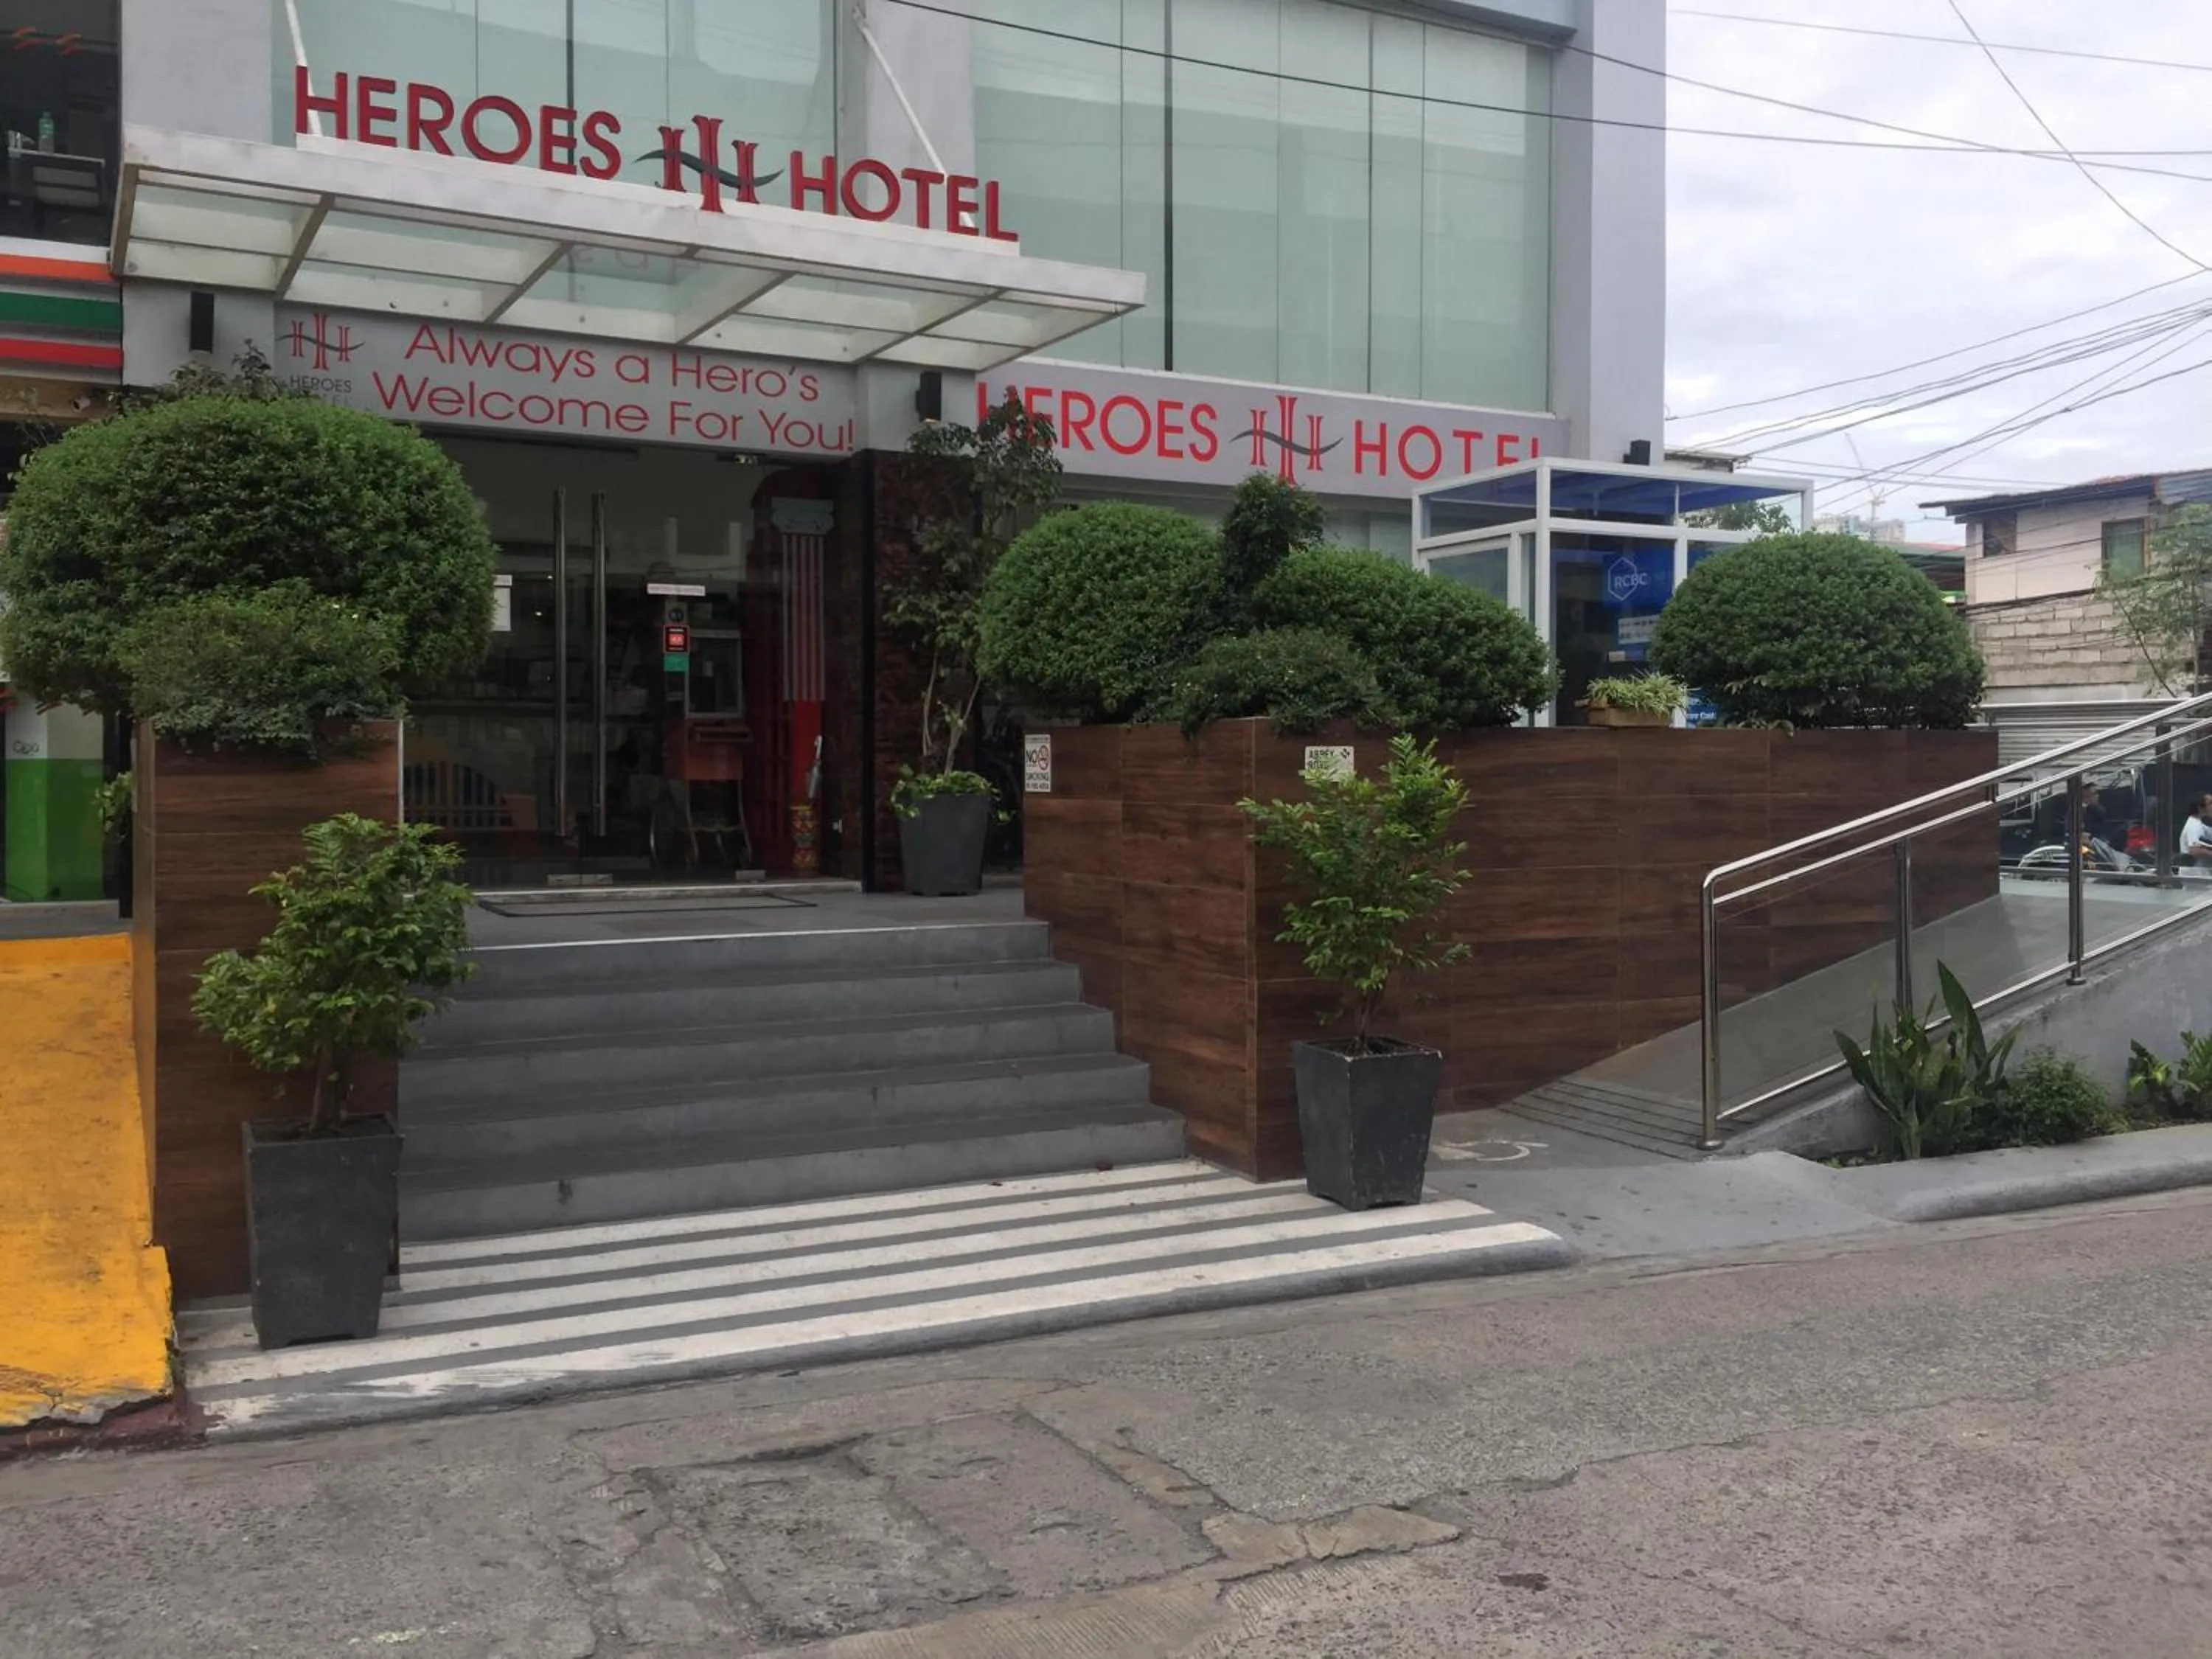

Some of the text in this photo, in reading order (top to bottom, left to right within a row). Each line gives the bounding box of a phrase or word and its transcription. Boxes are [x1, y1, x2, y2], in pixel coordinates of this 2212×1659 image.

[295, 65, 622, 181] HEROES
[790, 150, 1019, 242] HOTEL
[290, 375, 352, 394] HEROES
[404, 324, 819, 402] Always a Hero's
[372, 371, 854, 452] Welcome For You!
[1614, 572, 1648, 590] RCBC
[1026, 748, 1038, 764] NO
